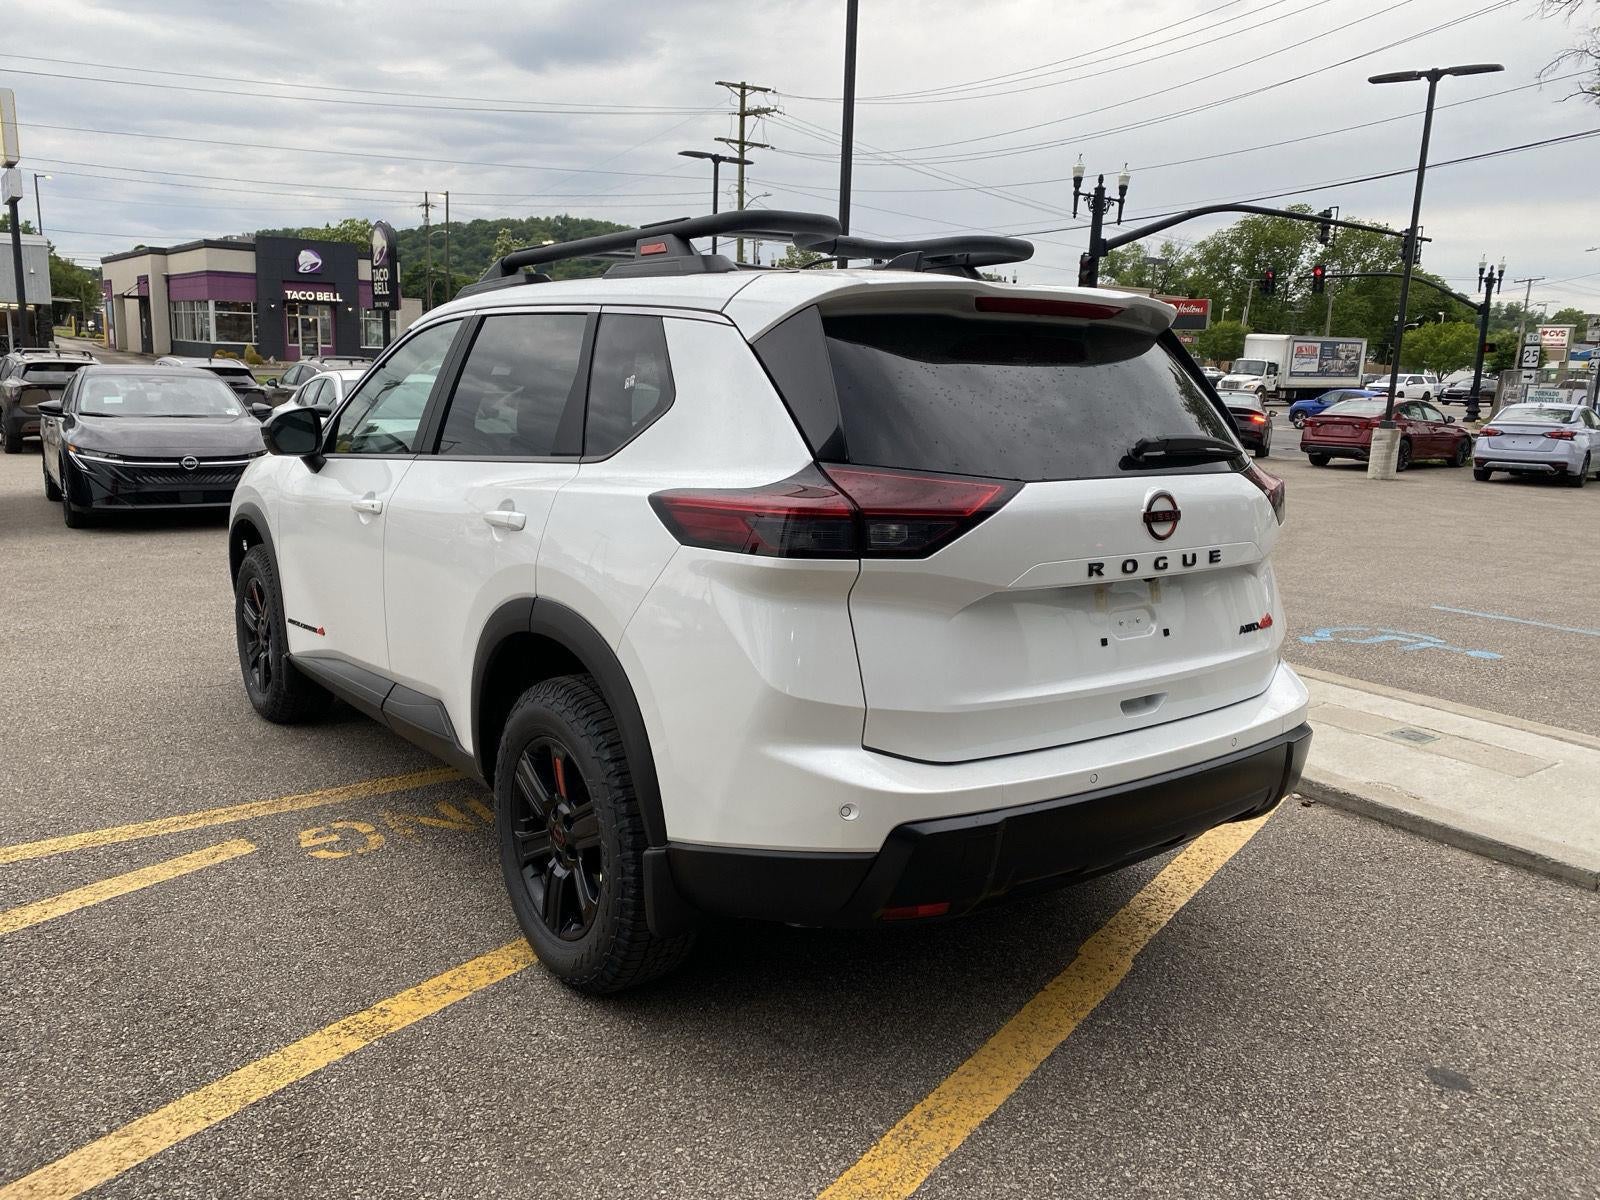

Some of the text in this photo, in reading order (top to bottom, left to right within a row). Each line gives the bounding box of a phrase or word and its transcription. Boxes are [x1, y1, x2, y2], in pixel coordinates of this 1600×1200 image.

[373, 268, 389, 282] TACO
[374, 282, 390, 295] BELL
[285, 290, 343, 302] TACO BELL
[1523, 350, 1539, 363] 25
[1087, 549, 1222, 577] ROGUE
